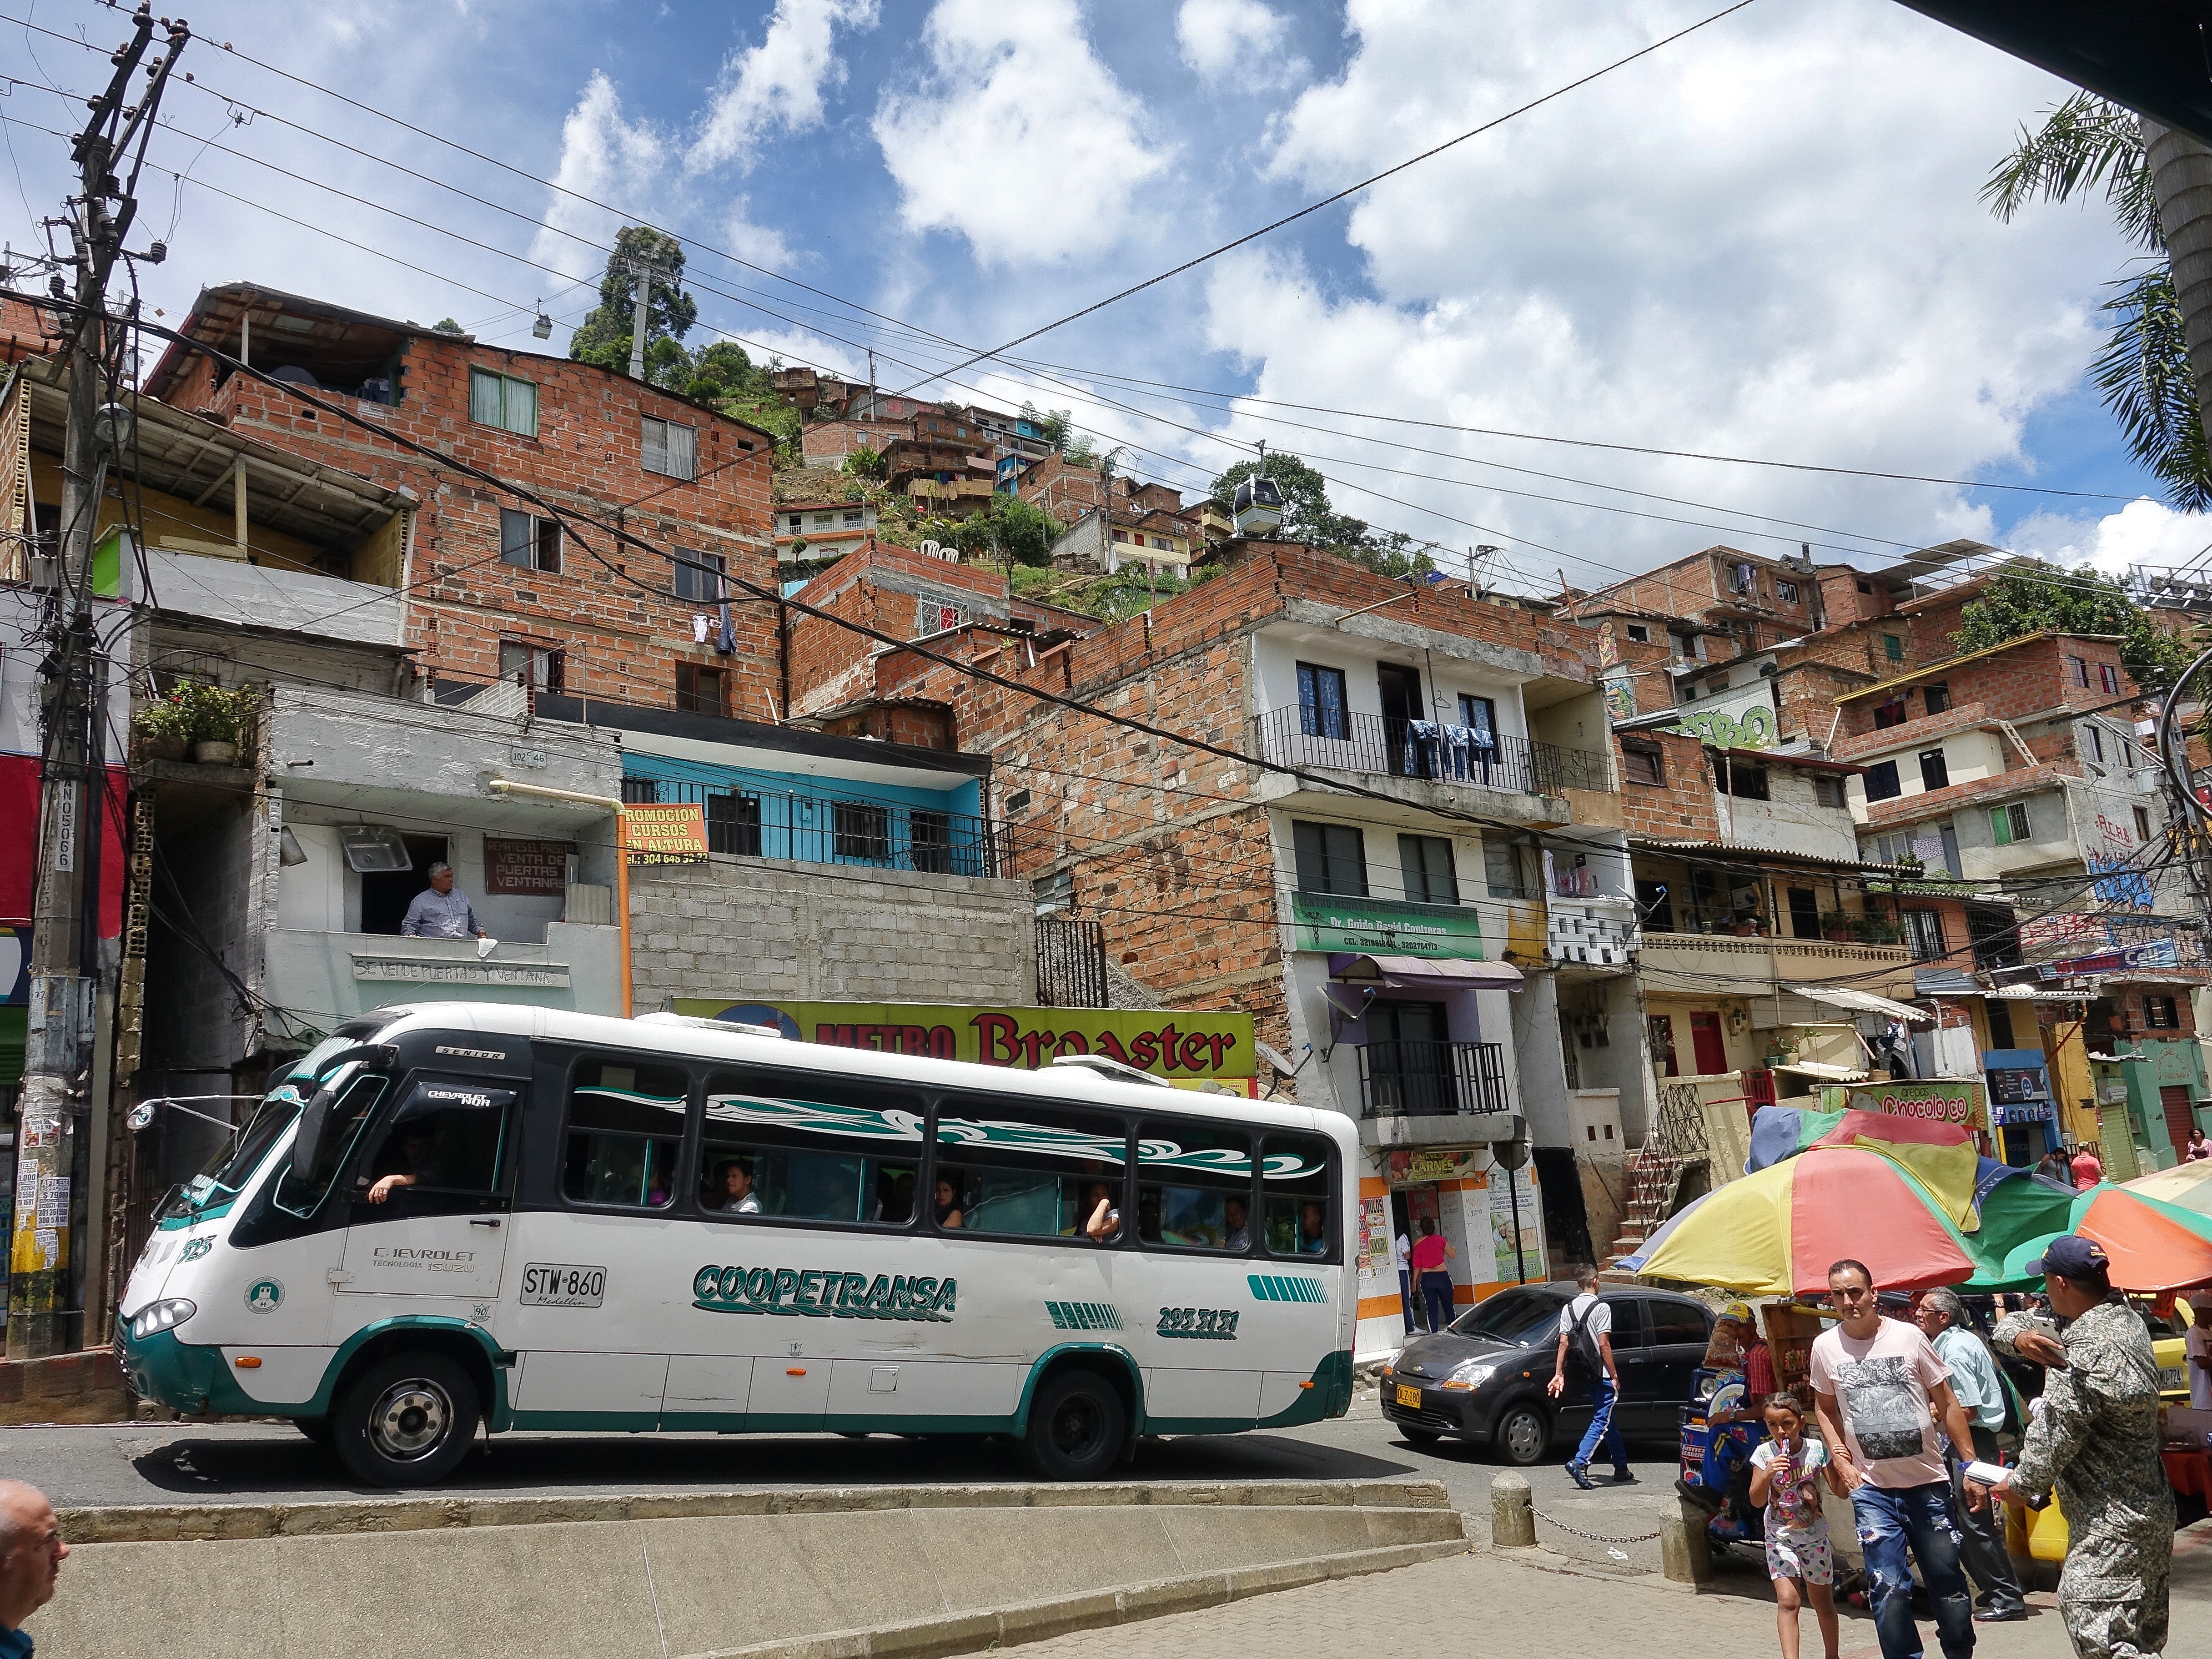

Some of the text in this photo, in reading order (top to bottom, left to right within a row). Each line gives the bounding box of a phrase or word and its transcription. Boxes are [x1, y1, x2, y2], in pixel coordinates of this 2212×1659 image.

[533, 754, 545, 762] 46
[626, 805, 699, 822] ROMOCIÓN
[631, 824, 689, 837] CURSOS
[648, 838, 704, 852] ALTURA
[498, 853, 565, 865] VENTA DE
[627, 855, 640, 865] el.:
[643, 854, 661, 864] 304
[496, 865, 558, 877] PUERTAS
[1347, 918, 1374, 929] Guido
[1376, 920, 1402, 931] David
[1404, 922, 1447, 935] Contreras
[1344, 937, 1358, 945] CEL:
[1401, 941, 1438, 950] 3202764713
[481, 965, 493, 982] Y
[969, 1012, 1237, 1071] Broaster
[442, 1048, 501, 1059] SENIOR
[427, 1091, 487, 1100] CHEVROLET
[1412, 1160, 1454, 1173] CARNES
[372, 1259, 475, 1273] TECNOLOGIA ISUZU
[693, 1264, 957, 1315] COOPETRANSA
[475, 1307, 487, 1316] 90
